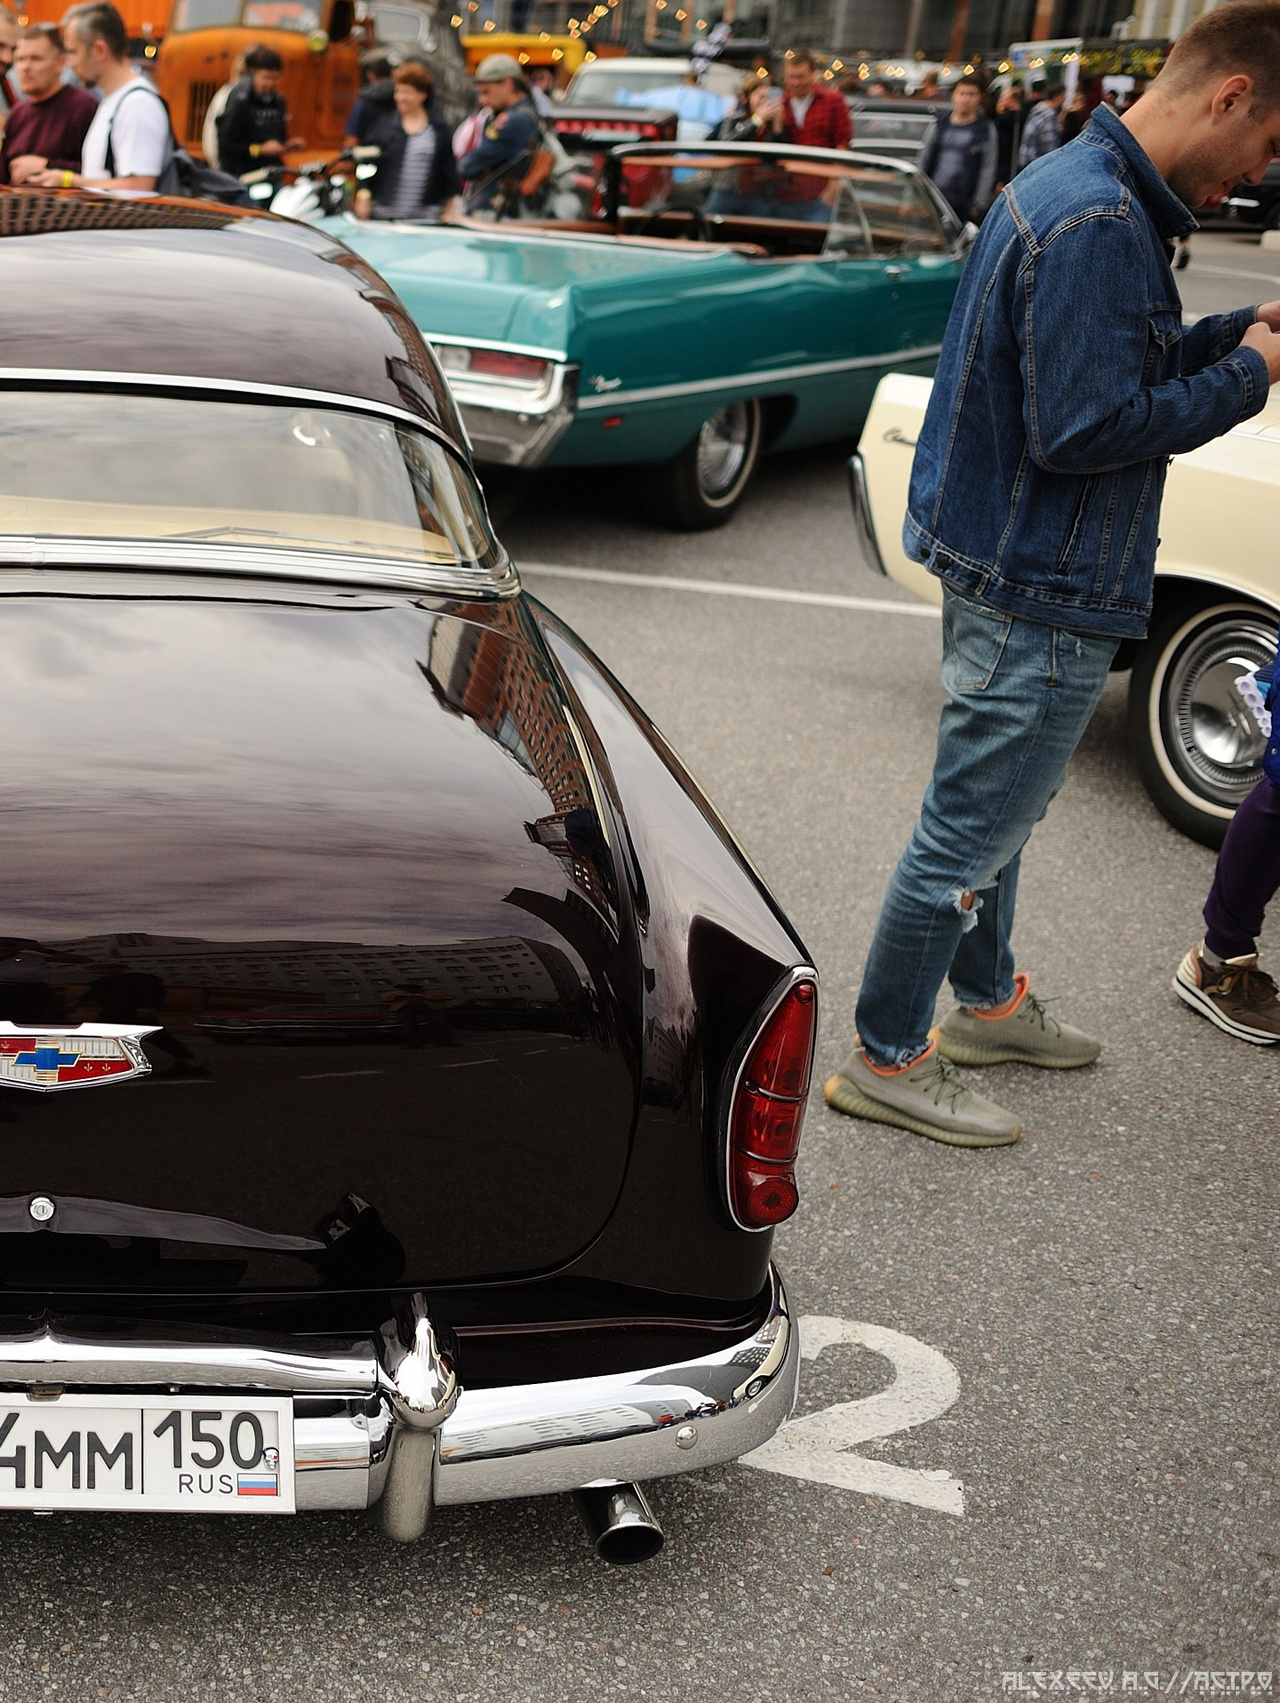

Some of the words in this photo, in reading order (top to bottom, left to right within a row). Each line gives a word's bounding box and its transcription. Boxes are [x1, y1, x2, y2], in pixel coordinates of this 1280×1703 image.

[153, 1410, 263, 1469] 150
[737, 1314, 964, 1517] 2
[179, 1473, 233, 1495] RUS
